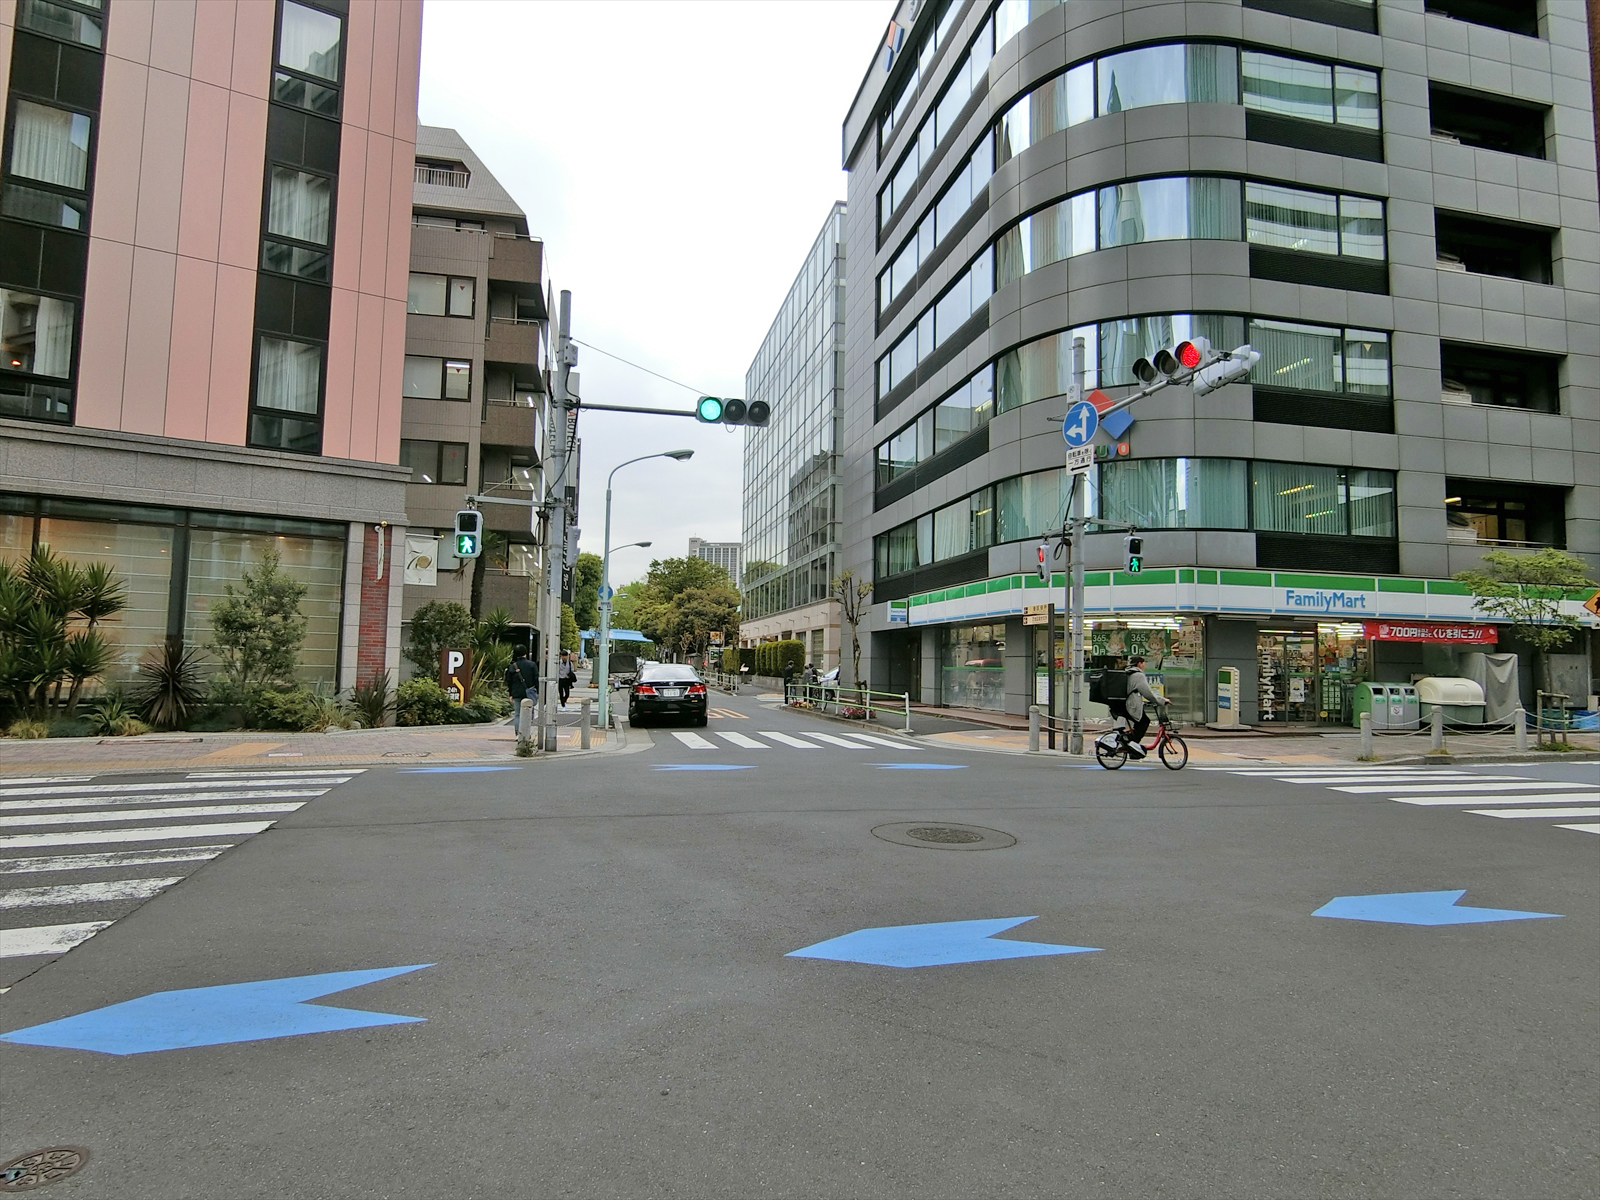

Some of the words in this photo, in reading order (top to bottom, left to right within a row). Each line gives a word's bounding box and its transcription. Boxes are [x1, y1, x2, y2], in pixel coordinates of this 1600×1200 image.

[566, 409, 577, 453] ABOTECH
[1286, 590, 1366, 612] FamilyMart
[1390, 626, 1417, 637] 700円
[448, 651, 464, 675] P
[1259, 638, 1275, 721] FamilyMart
